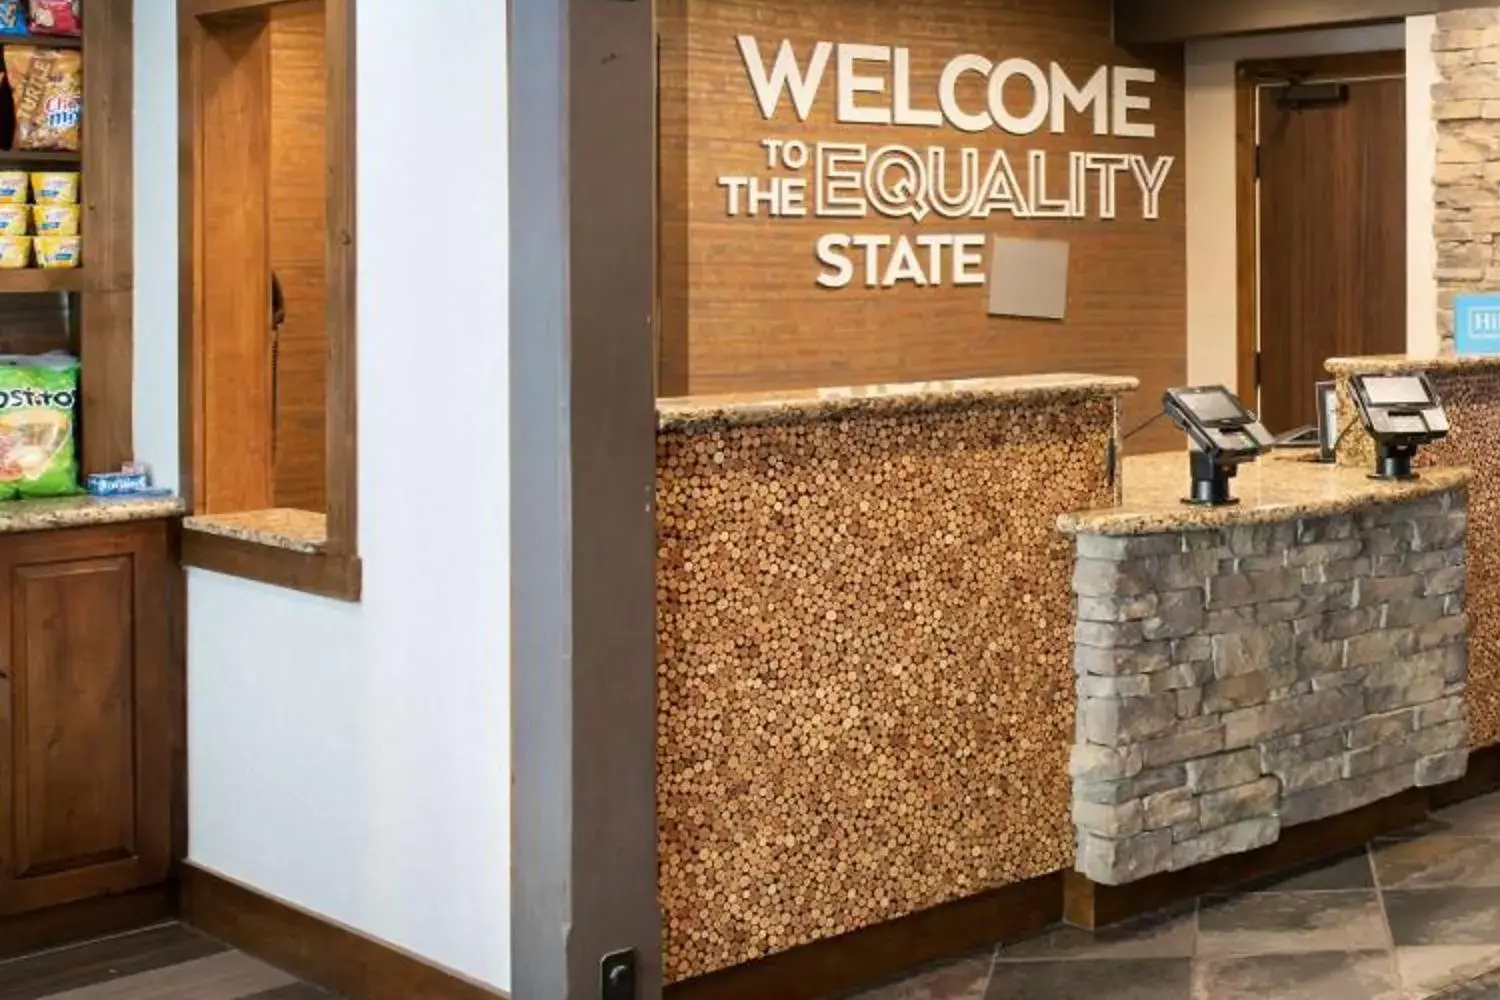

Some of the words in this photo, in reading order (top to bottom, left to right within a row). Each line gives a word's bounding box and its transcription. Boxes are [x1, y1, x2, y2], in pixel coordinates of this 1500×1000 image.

[16, 59, 51, 120] TURTLE
[44, 91, 80, 113] Che
[736, 34, 1157, 138] WELCOME
[718, 175, 807, 216] THE
[815, 142, 1175, 222] EQUALITY
[762, 139, 808, 169] TO
[815, 233, 986, 288] STATE
